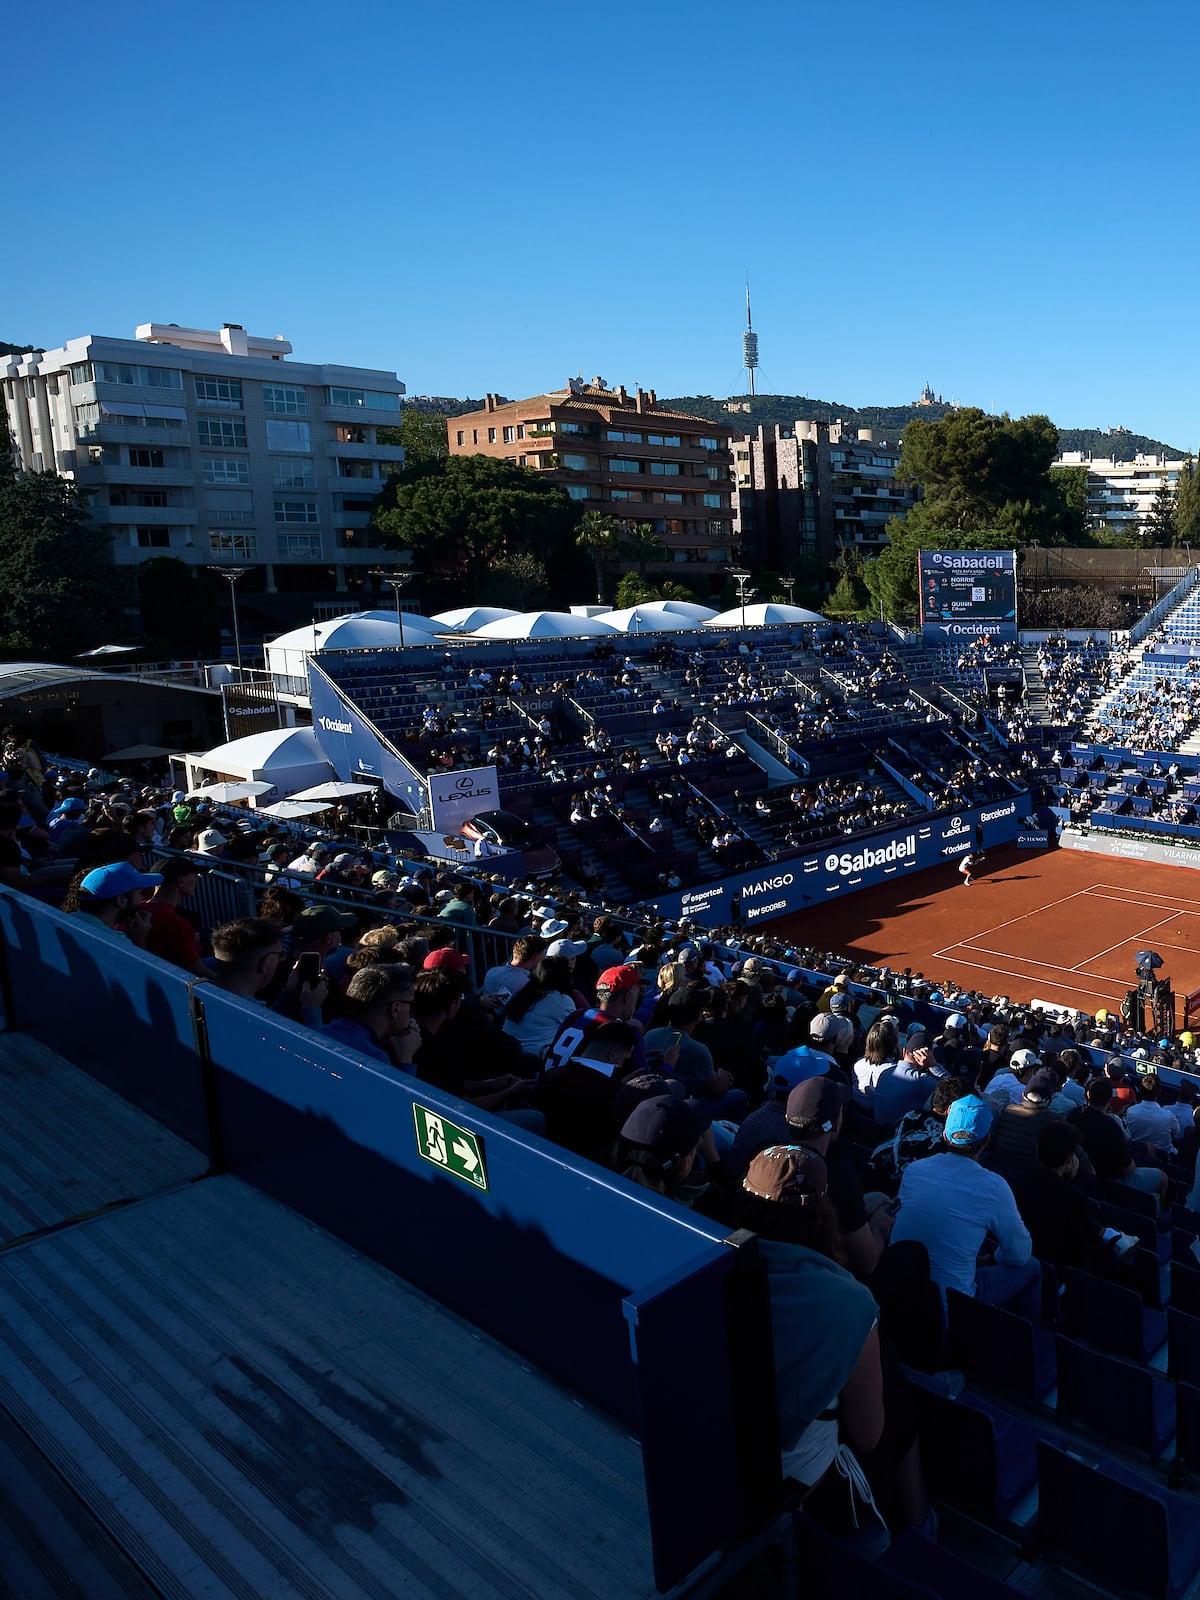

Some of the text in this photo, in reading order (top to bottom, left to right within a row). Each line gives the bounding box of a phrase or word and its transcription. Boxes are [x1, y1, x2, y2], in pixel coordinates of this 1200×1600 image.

[943, 556, 1003, 569] Sabadell
[952, 624, 1001, 635] Occident
[235, 705, 276, 716] Sabadell
[519, 699, 554, 711] Haier
[326, 718, 353, 735] Occident
[439, 787, 492, 803] LEXUS
[981, 806, 1011, 822] Barcelona
[942, 824, 971, 838] LEXUS
[839, 834, 916, 876] Sabadell
[948, 841, 972, 854] Occident
[742, 873, 794, 898] MANGO
[690, 886, 724, 903] esportcat
[761, 900, 787, 914] SCORES
[545, 1027, 585, 1073] 9
